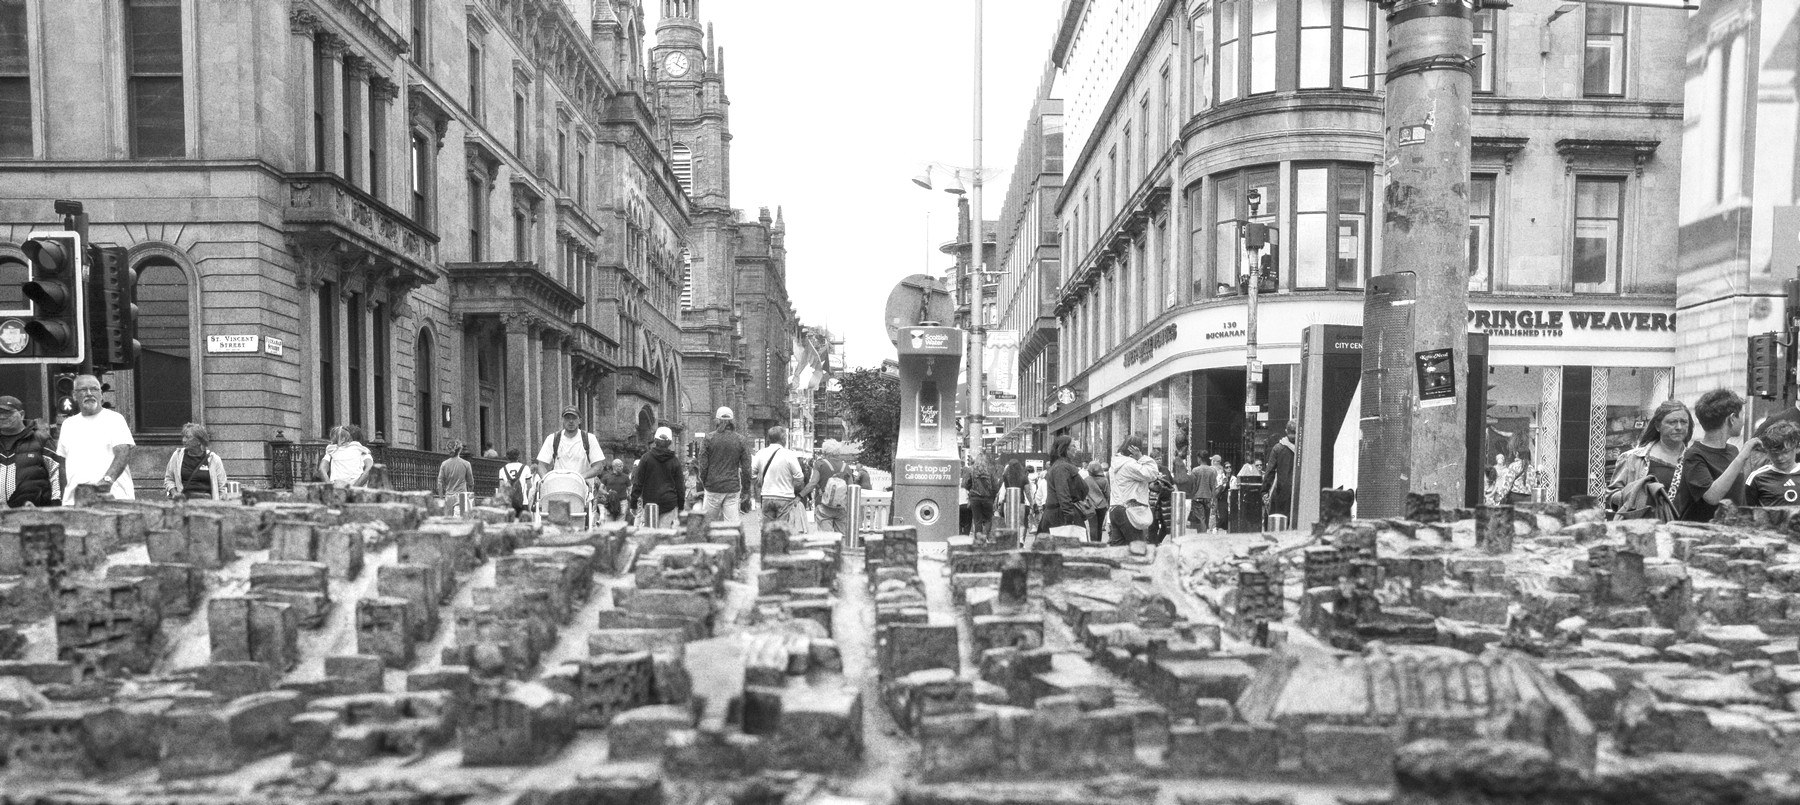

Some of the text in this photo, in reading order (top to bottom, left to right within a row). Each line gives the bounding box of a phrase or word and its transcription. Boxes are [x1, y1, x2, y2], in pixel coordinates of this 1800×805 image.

[1223, 321, 1237, 329] 130
[1569, 311, 1676, 332] WEAVERS
[925, 333, 949, 341] Scottish
[1205, 329, 1246, 340] BUCHANAN
[905, 463, 952, 475] Can't top up?
